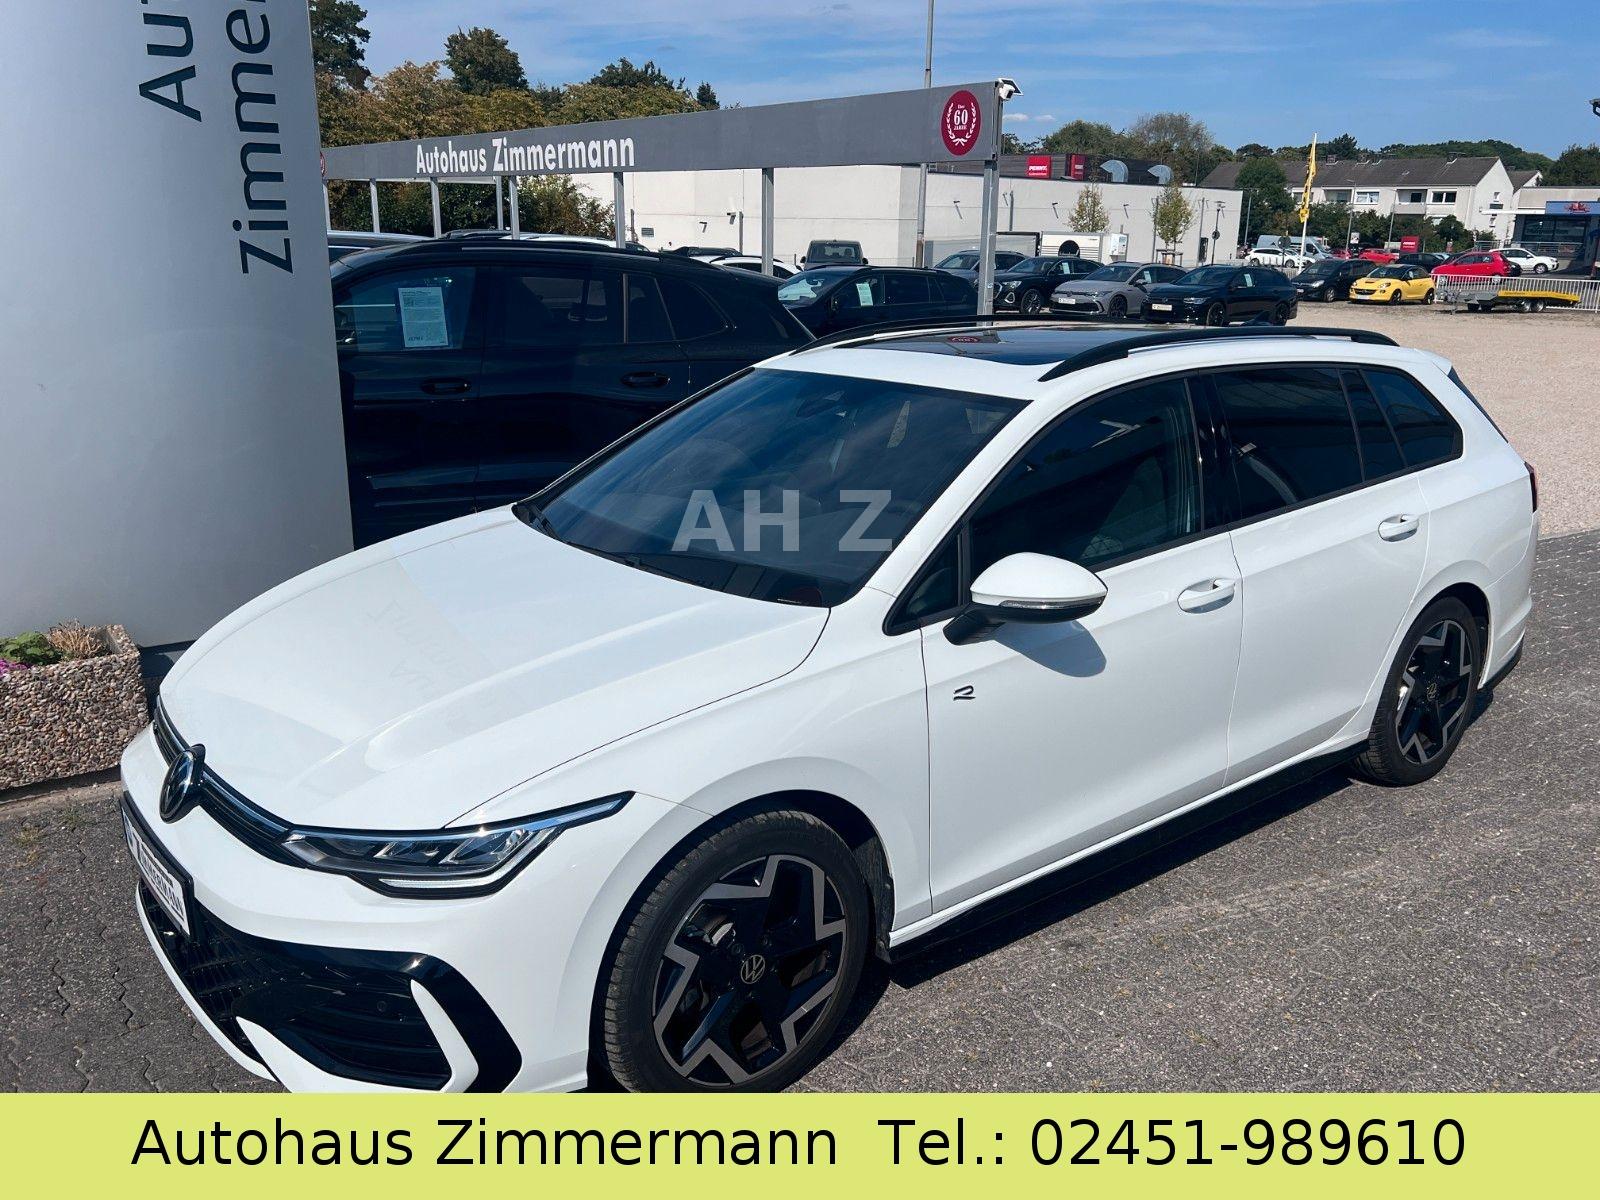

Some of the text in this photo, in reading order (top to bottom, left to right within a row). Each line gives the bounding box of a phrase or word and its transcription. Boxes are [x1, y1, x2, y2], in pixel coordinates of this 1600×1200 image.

[139, 0, 203, 122] Au
[226, 0, 293, 274] Zimme
[416, 136, 635, 174] Autohaus Zimmermann
[954, 109, 969, 125] 60
